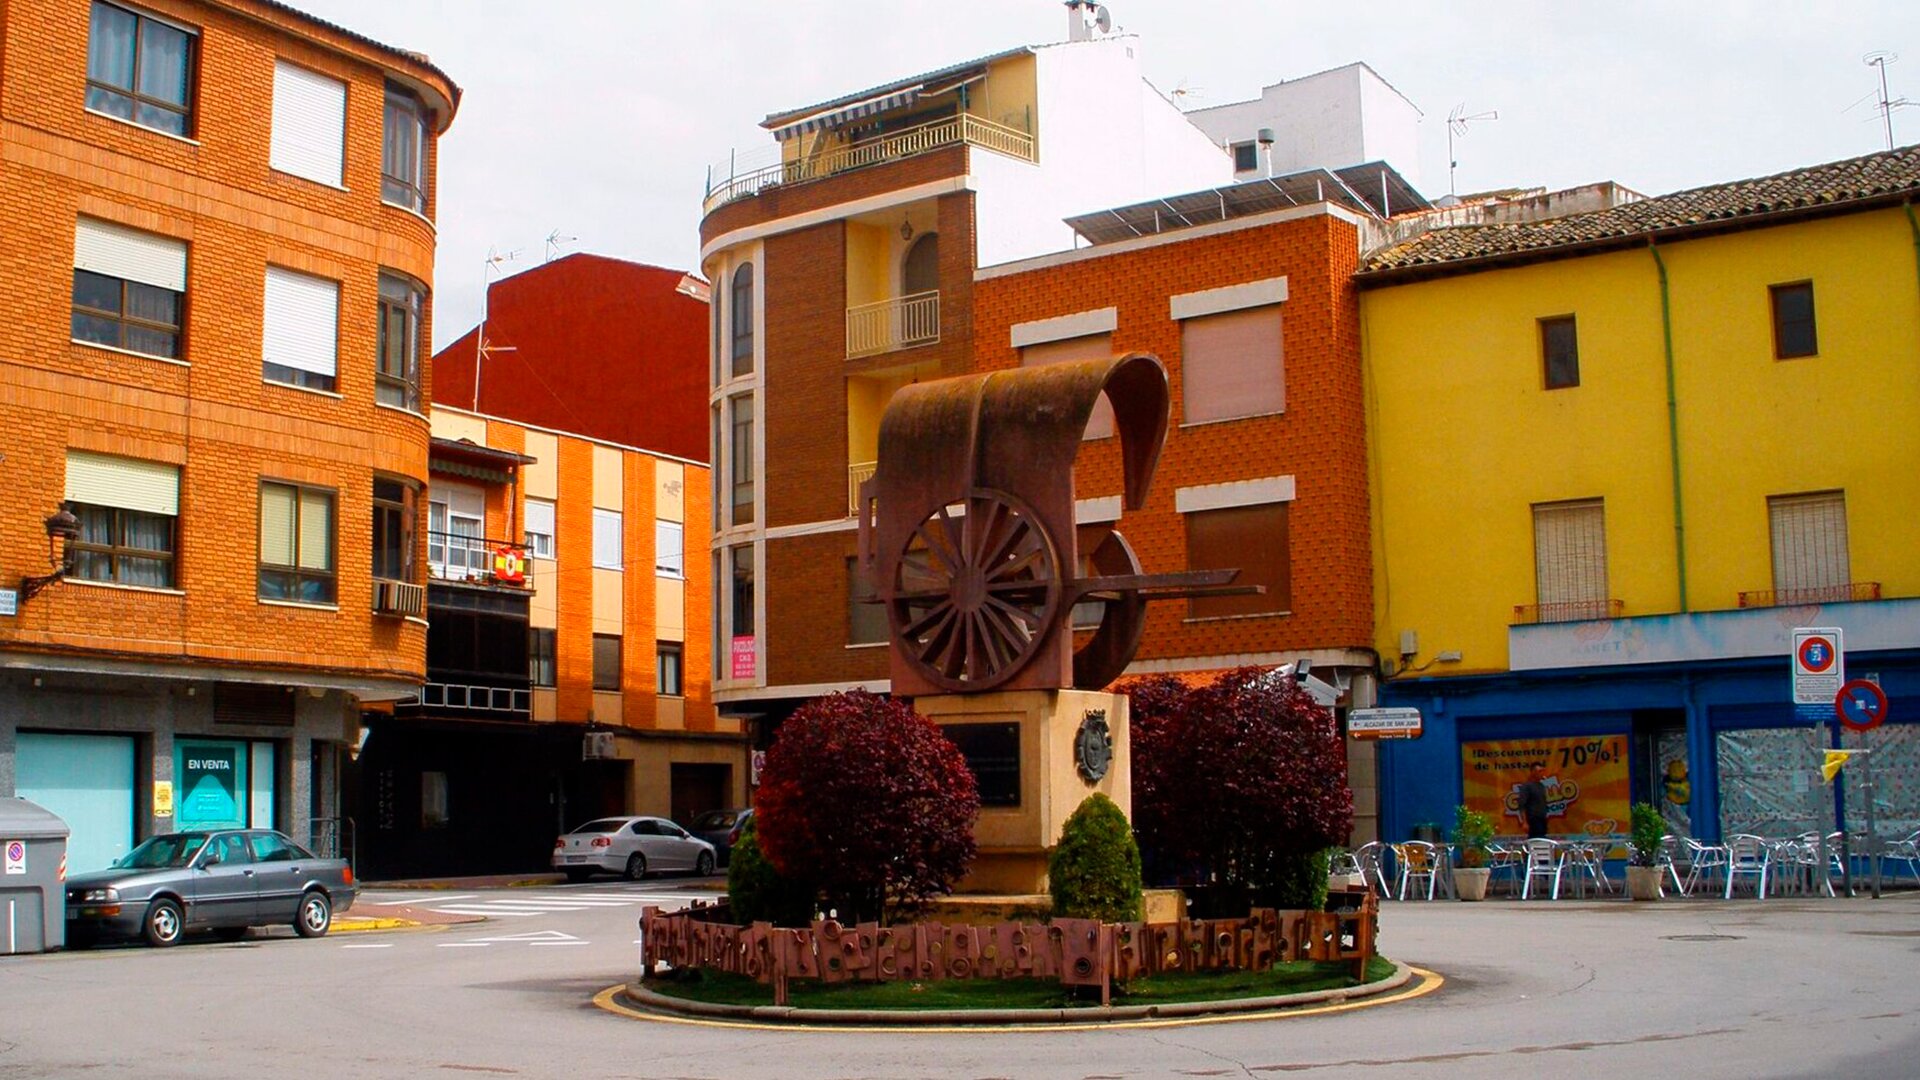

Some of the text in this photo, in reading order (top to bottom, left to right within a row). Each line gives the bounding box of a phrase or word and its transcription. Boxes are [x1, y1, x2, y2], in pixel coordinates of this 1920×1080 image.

[188, 759, 230, 770] EN VENTA
[1475, 761, 1489, 770] de
